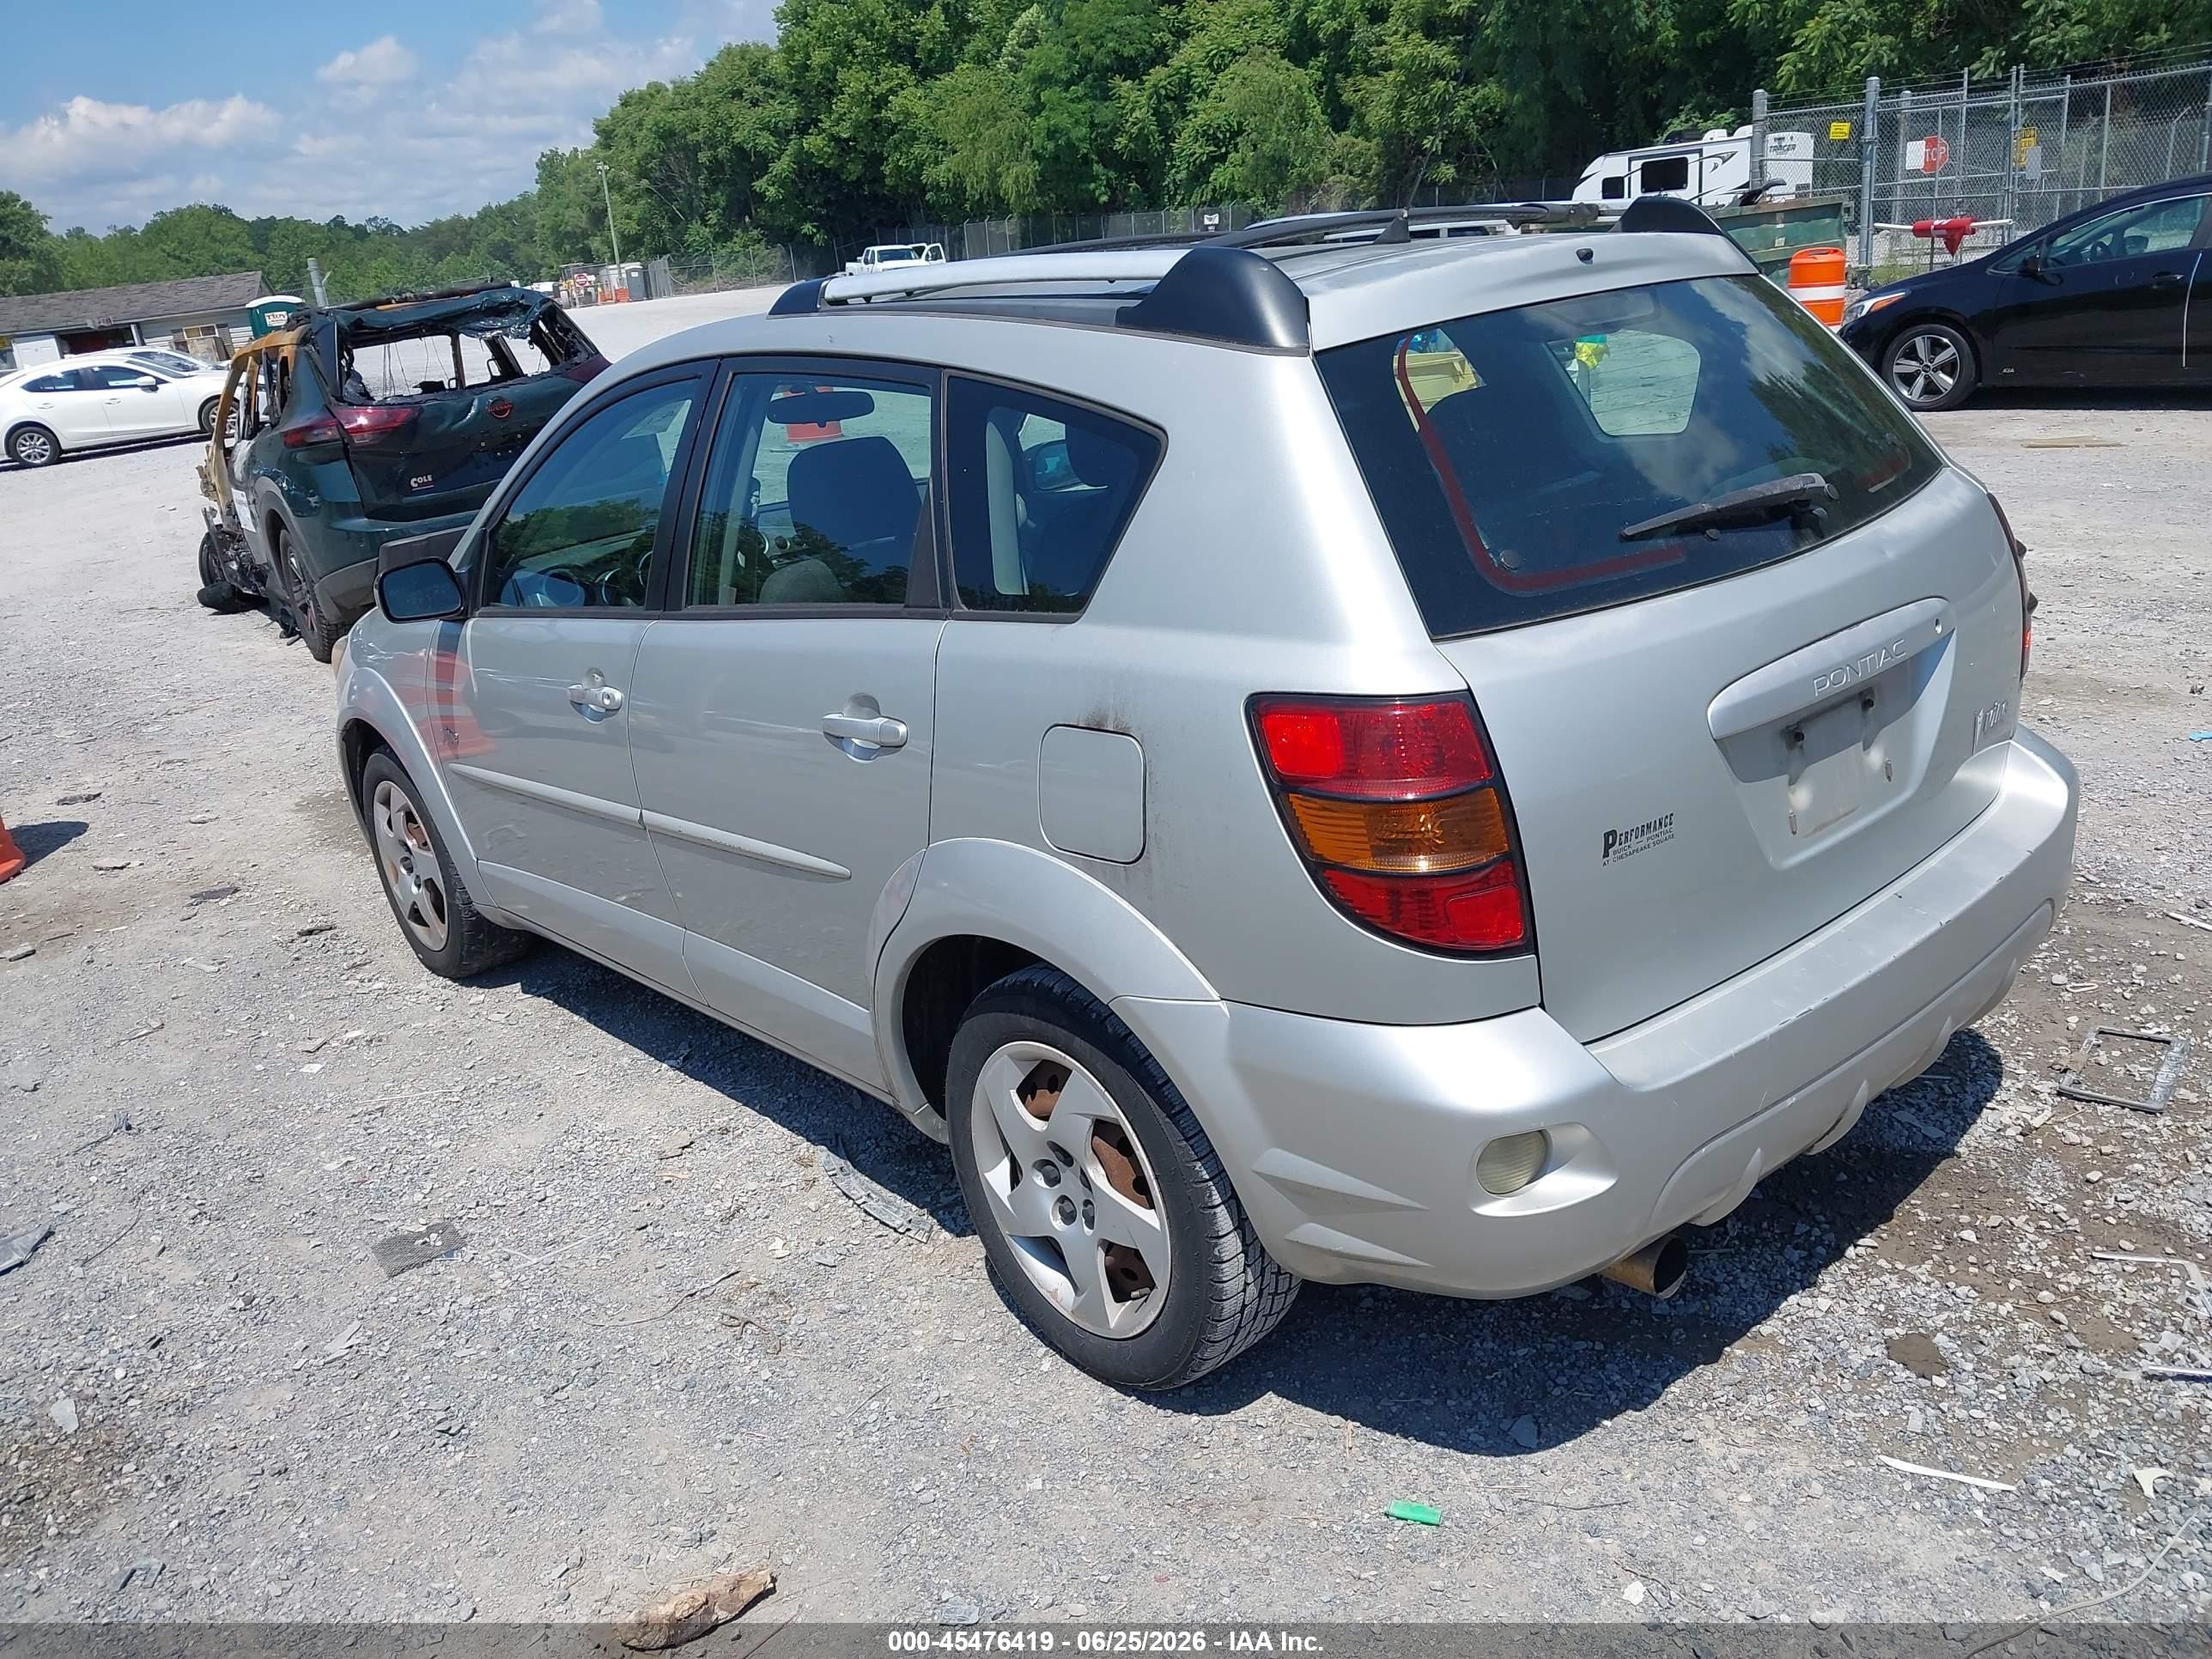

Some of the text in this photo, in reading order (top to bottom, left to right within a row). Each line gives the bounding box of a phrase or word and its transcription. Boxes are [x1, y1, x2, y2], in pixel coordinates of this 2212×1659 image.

[1769, 144, 1796, 153] TRACER
[1925, 146, 1947, 162] TOP
[410, 475, 433, 488] COLE
[1814, 639, 1906, 696] PONTIAC
[1602, 812, 1674, 859] PERFORMANCE
[1613, 843, 1632, 856] BUICK
[1646, 827, 1674, 842] PONTIAC
[1613, 843, 1650, 863] CHESAPEAKE
[1652, 833, 1675, 848] SQUARE
